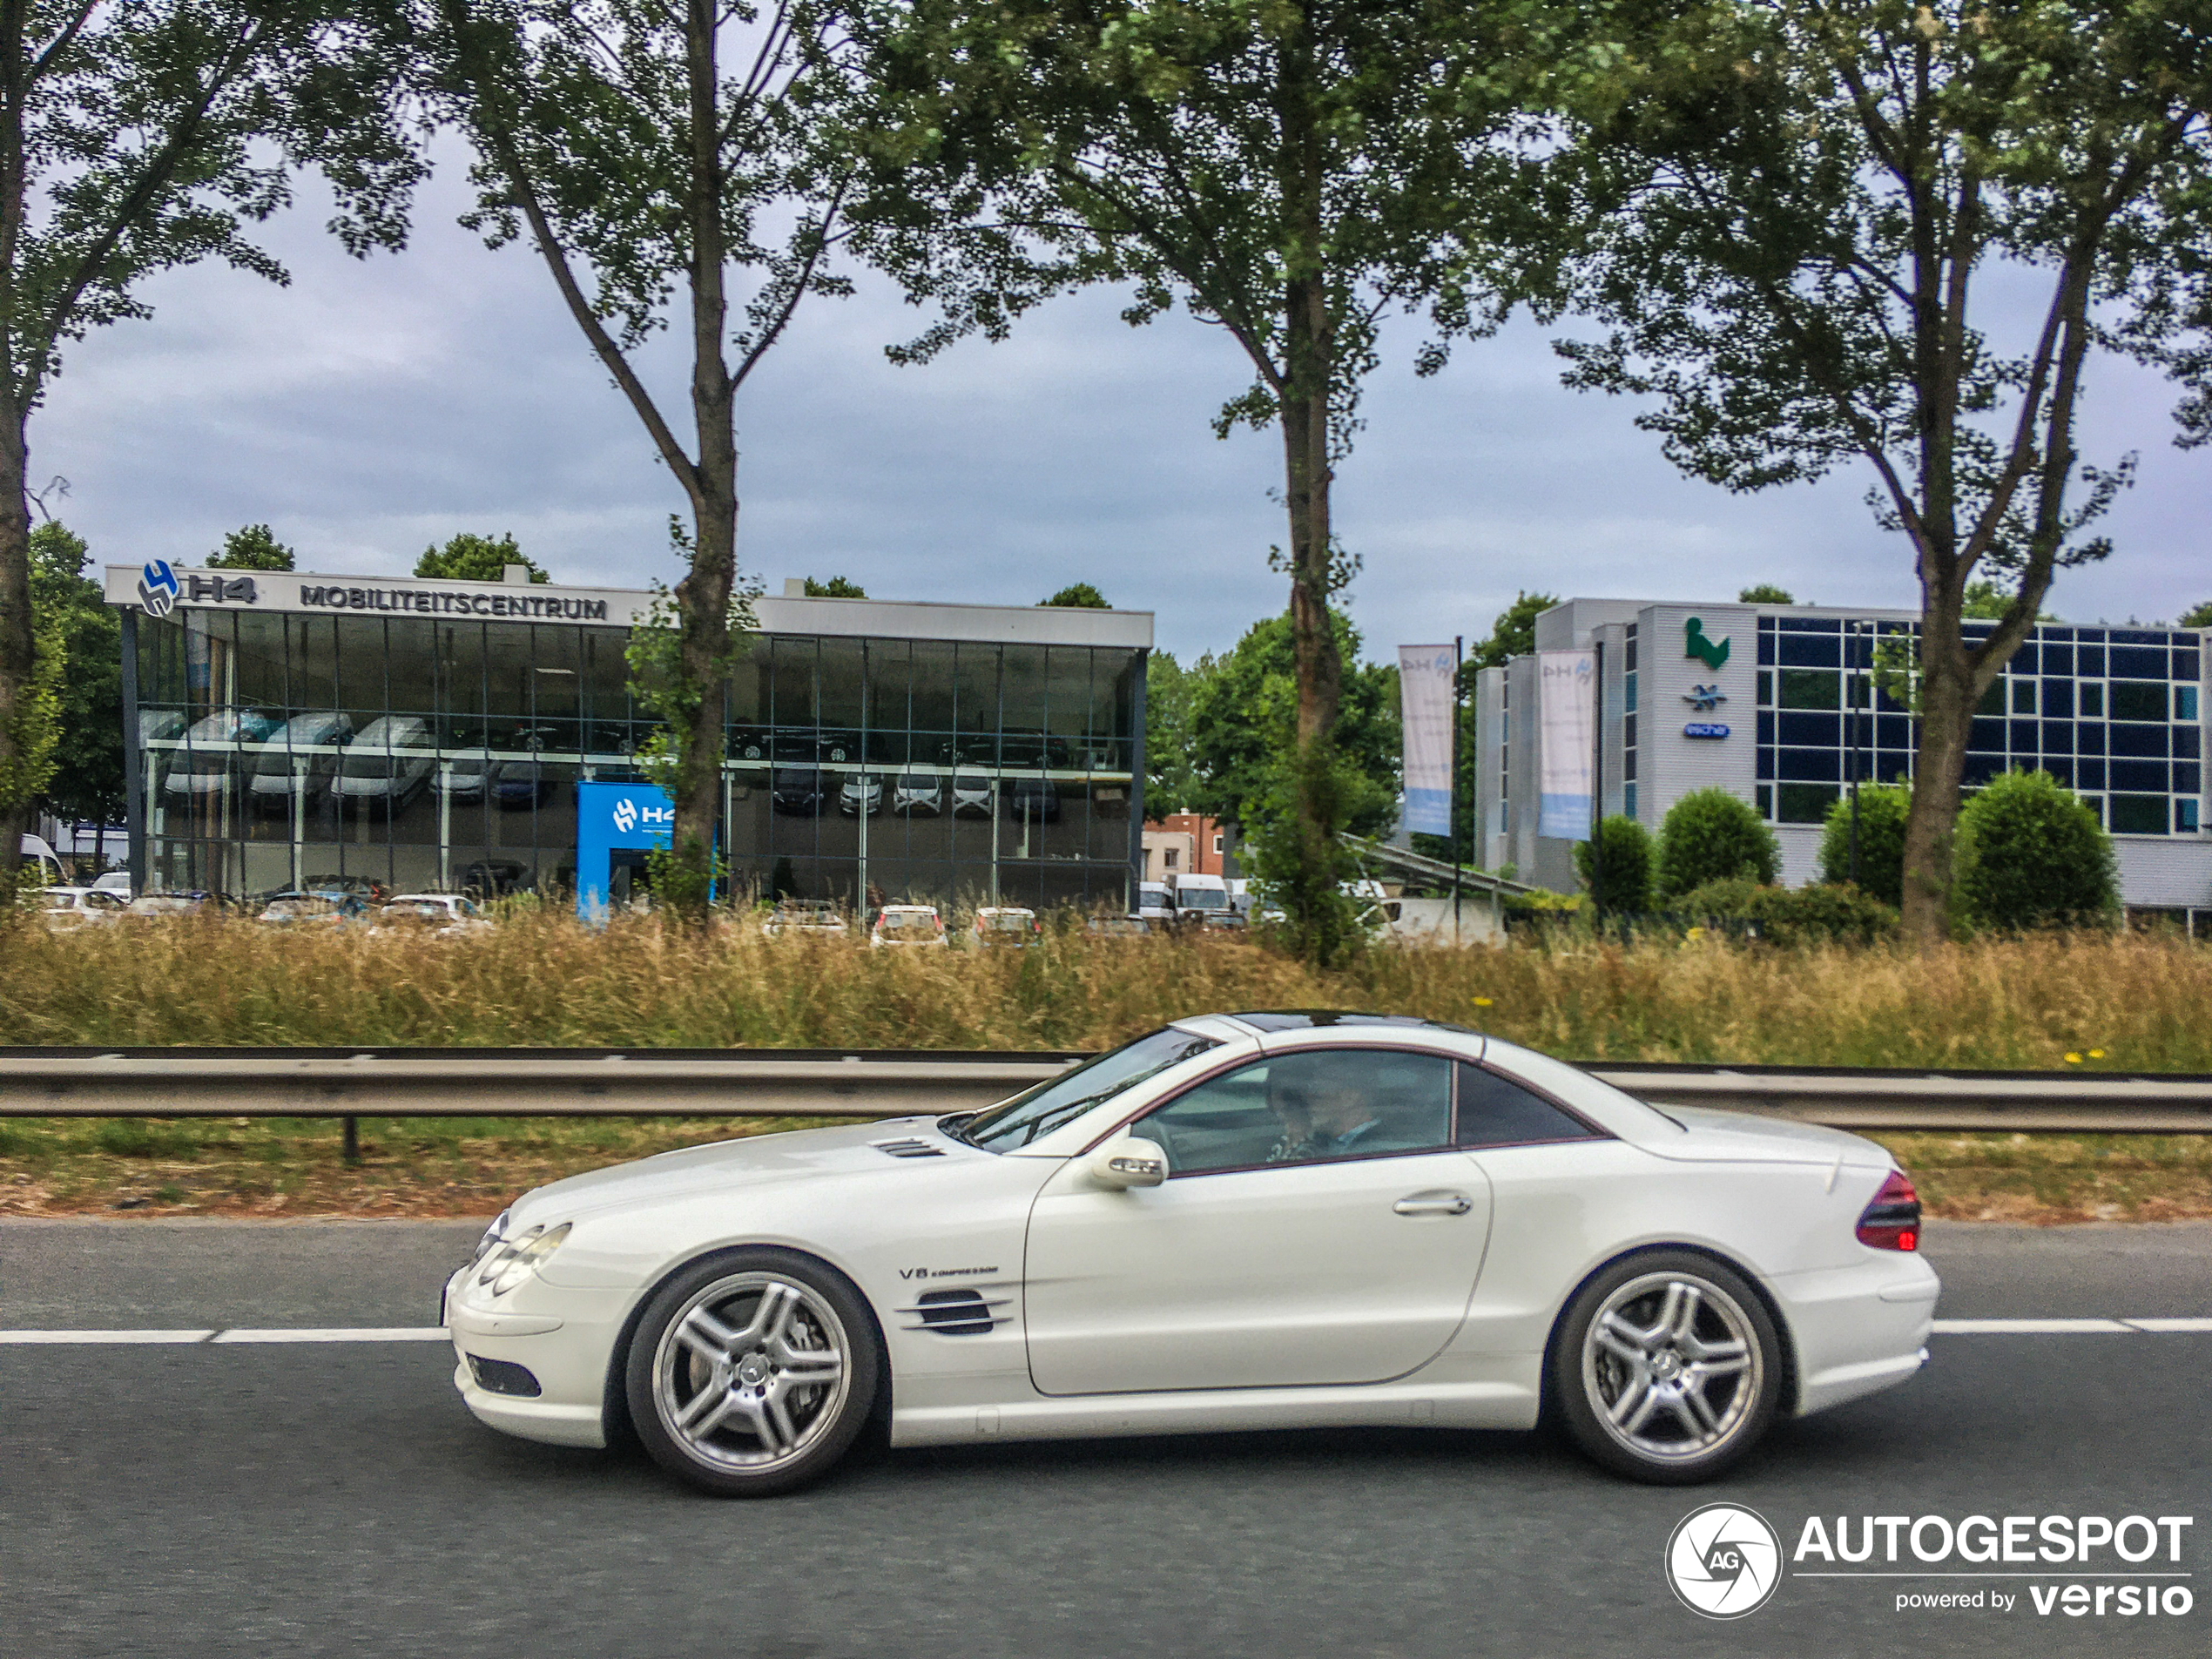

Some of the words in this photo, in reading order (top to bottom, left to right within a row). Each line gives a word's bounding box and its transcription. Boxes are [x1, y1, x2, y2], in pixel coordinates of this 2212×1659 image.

[188, 574, 257, 604] H4
[300, 584, 608, 620] MOBILITEITSCENTRUM
[899, 1268, 927, 1279] V8
